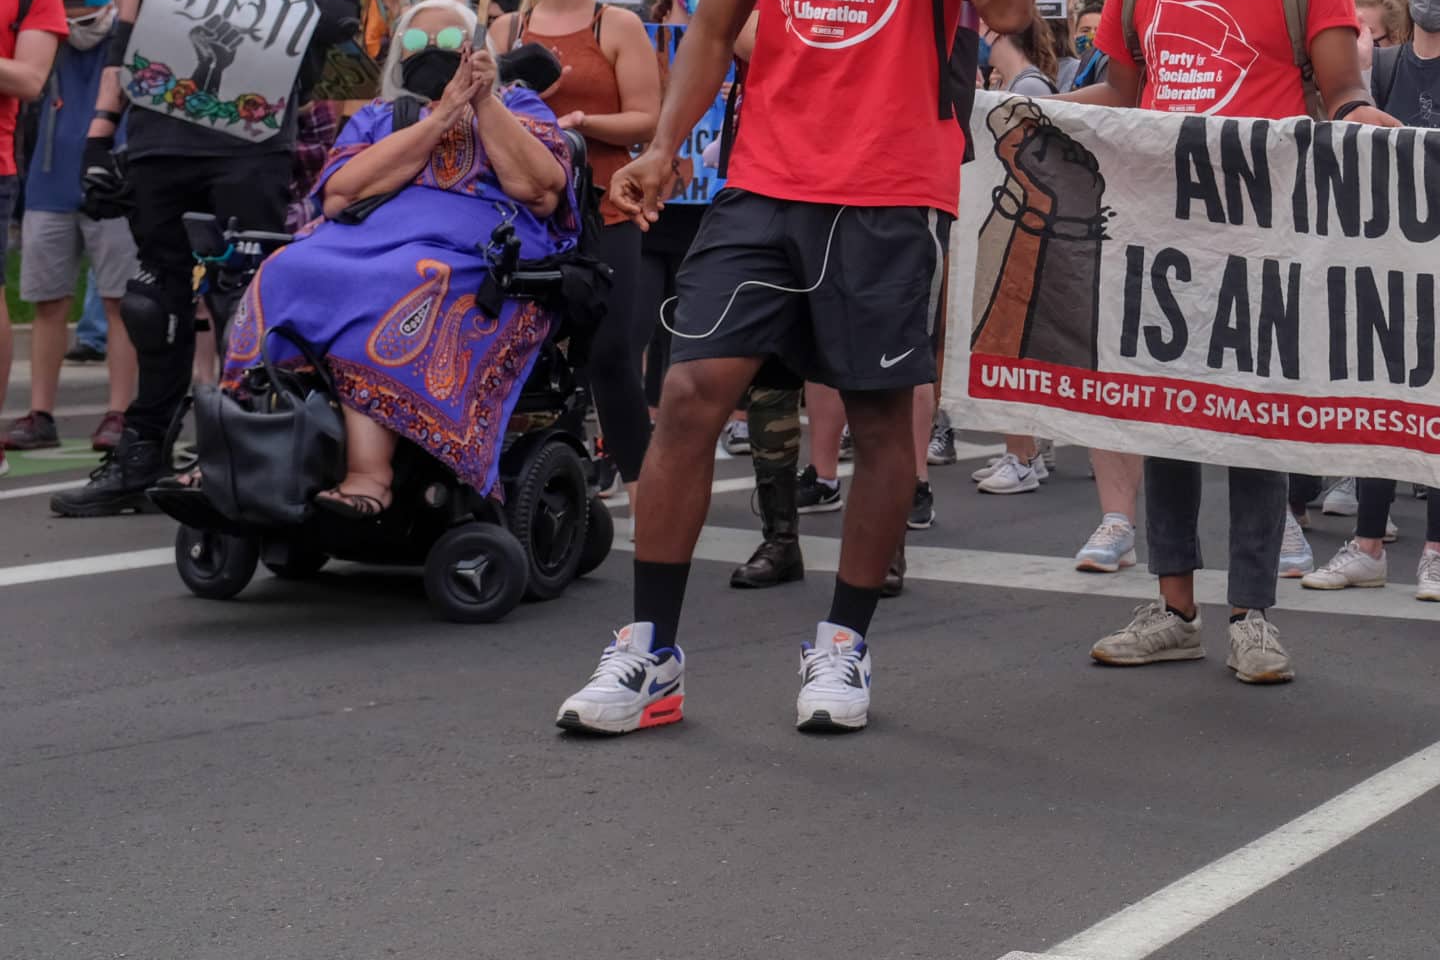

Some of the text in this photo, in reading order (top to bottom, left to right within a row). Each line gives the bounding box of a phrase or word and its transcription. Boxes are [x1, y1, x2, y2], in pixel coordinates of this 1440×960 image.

[794, 0, 868, 24] Liberation
[1160, 50, 1195, 68] Party
[1158, 67, 1223, 83] Socialism &
[1157, 84, 1216, 100] Liberation
[1175, 115, 1272, 229] AN
[1120, 244, 1192, 362] IS
[1207, 254, 1302, 380] AN
[981, 365, 1052, 393] UNITE
[1056, 375, 1076, 398] &
[1082, 378, 1155, 408] FIGHT
[1163, 388, 1196, 413] TO
[1202, 393, 1289, 427] SMASH
